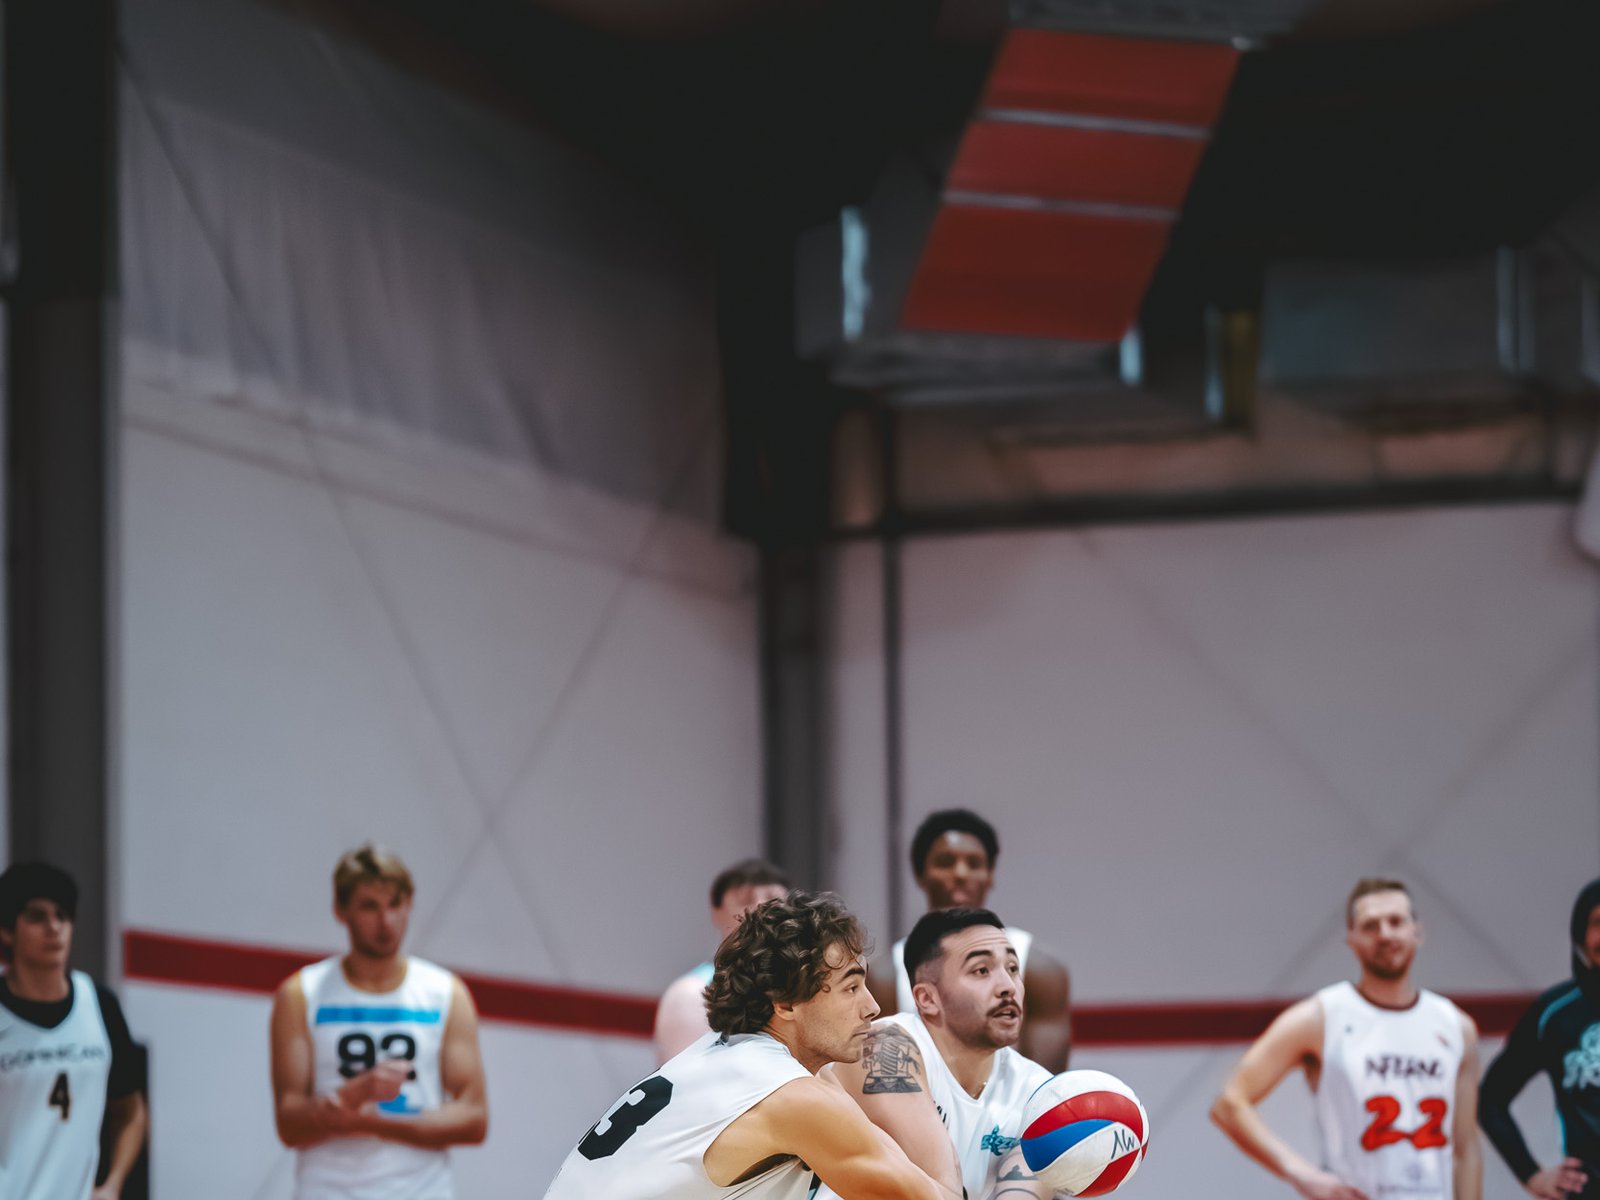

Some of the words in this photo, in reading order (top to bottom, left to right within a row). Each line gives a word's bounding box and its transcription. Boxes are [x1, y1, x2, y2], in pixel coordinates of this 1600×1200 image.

[49, 1072, 70, 1120] 4
[578, 1075, 673, 1161] 3
[1361, 1095, 1447, 1151] 22
